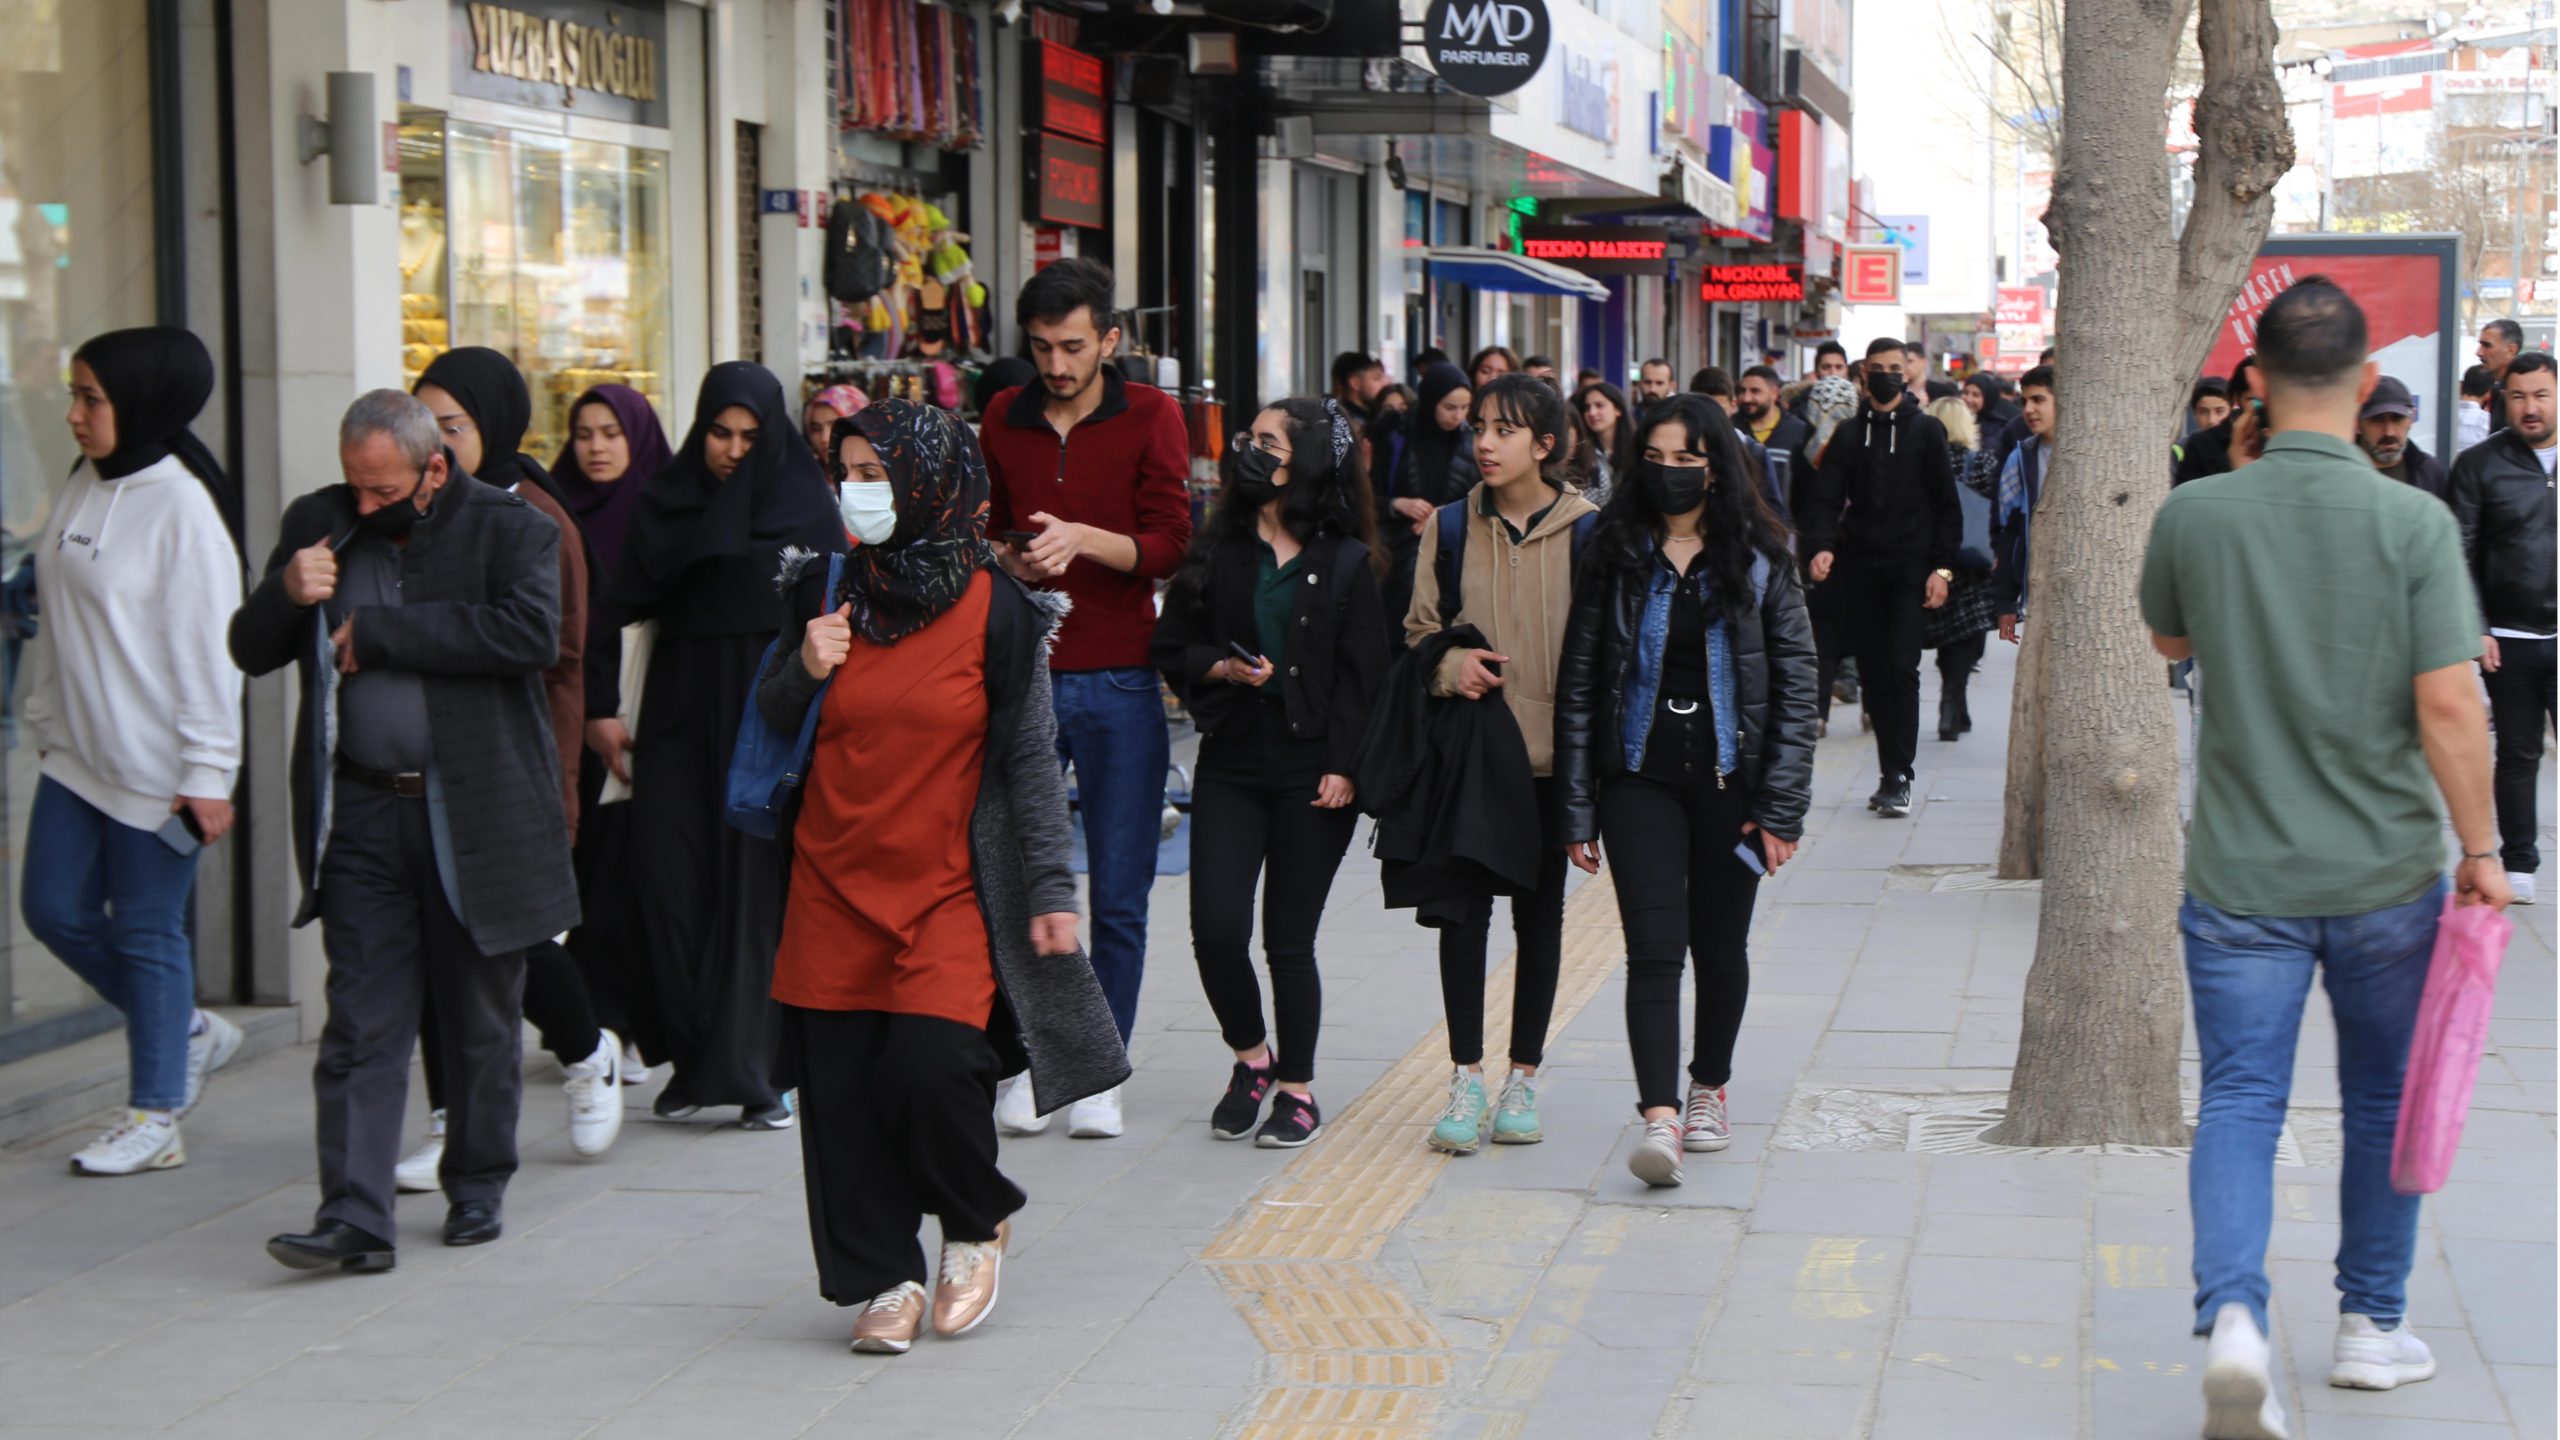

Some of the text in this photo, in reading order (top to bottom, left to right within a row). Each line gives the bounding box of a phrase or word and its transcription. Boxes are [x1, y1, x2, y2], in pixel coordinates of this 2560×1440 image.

[1440, 0, 1534, 46] MAD
[1440, 50, 1530, 66] PARFUMEUR
[1524, 239, 1666, 258] TEKNO MARKET
[1858, 257, 1888, 293] E
